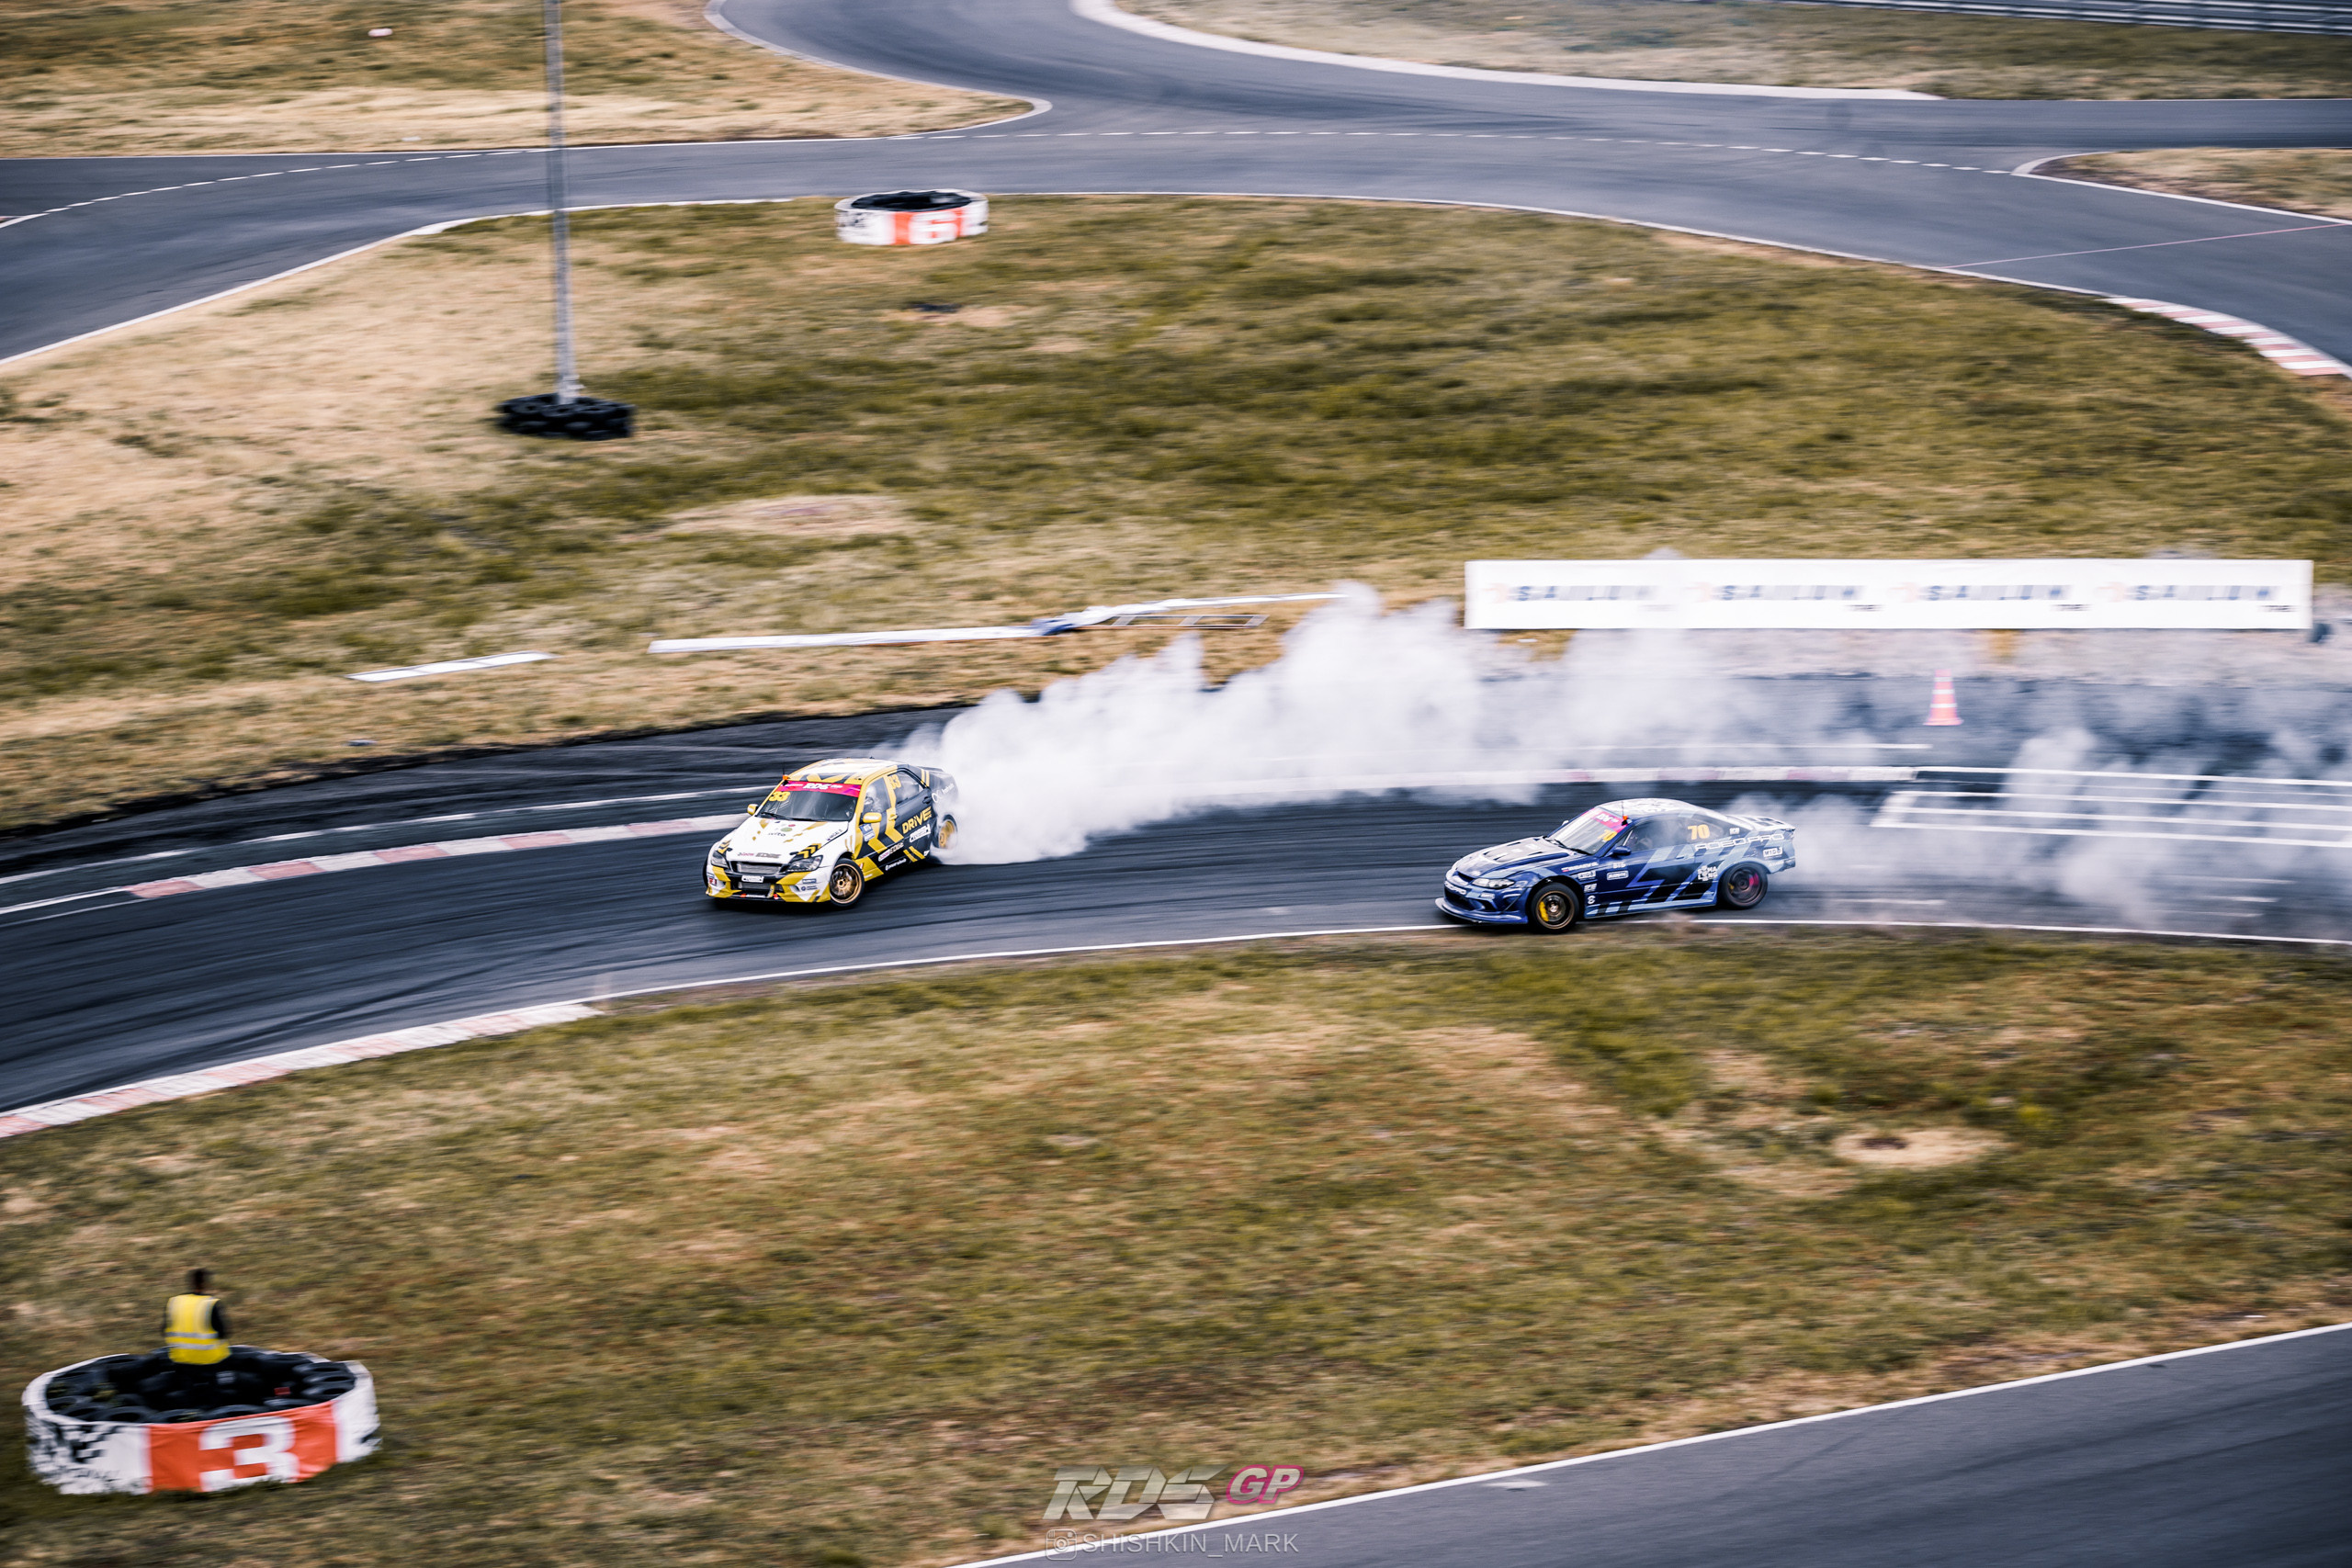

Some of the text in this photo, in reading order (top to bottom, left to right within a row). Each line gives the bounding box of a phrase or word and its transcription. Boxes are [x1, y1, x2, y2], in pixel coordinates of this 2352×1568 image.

[909, 210, 959, 244] 6
[769, 791, 791, 802] 33
[1687, 824, 1711, 840] 70
[198, 1416, 300, 1492] 3
